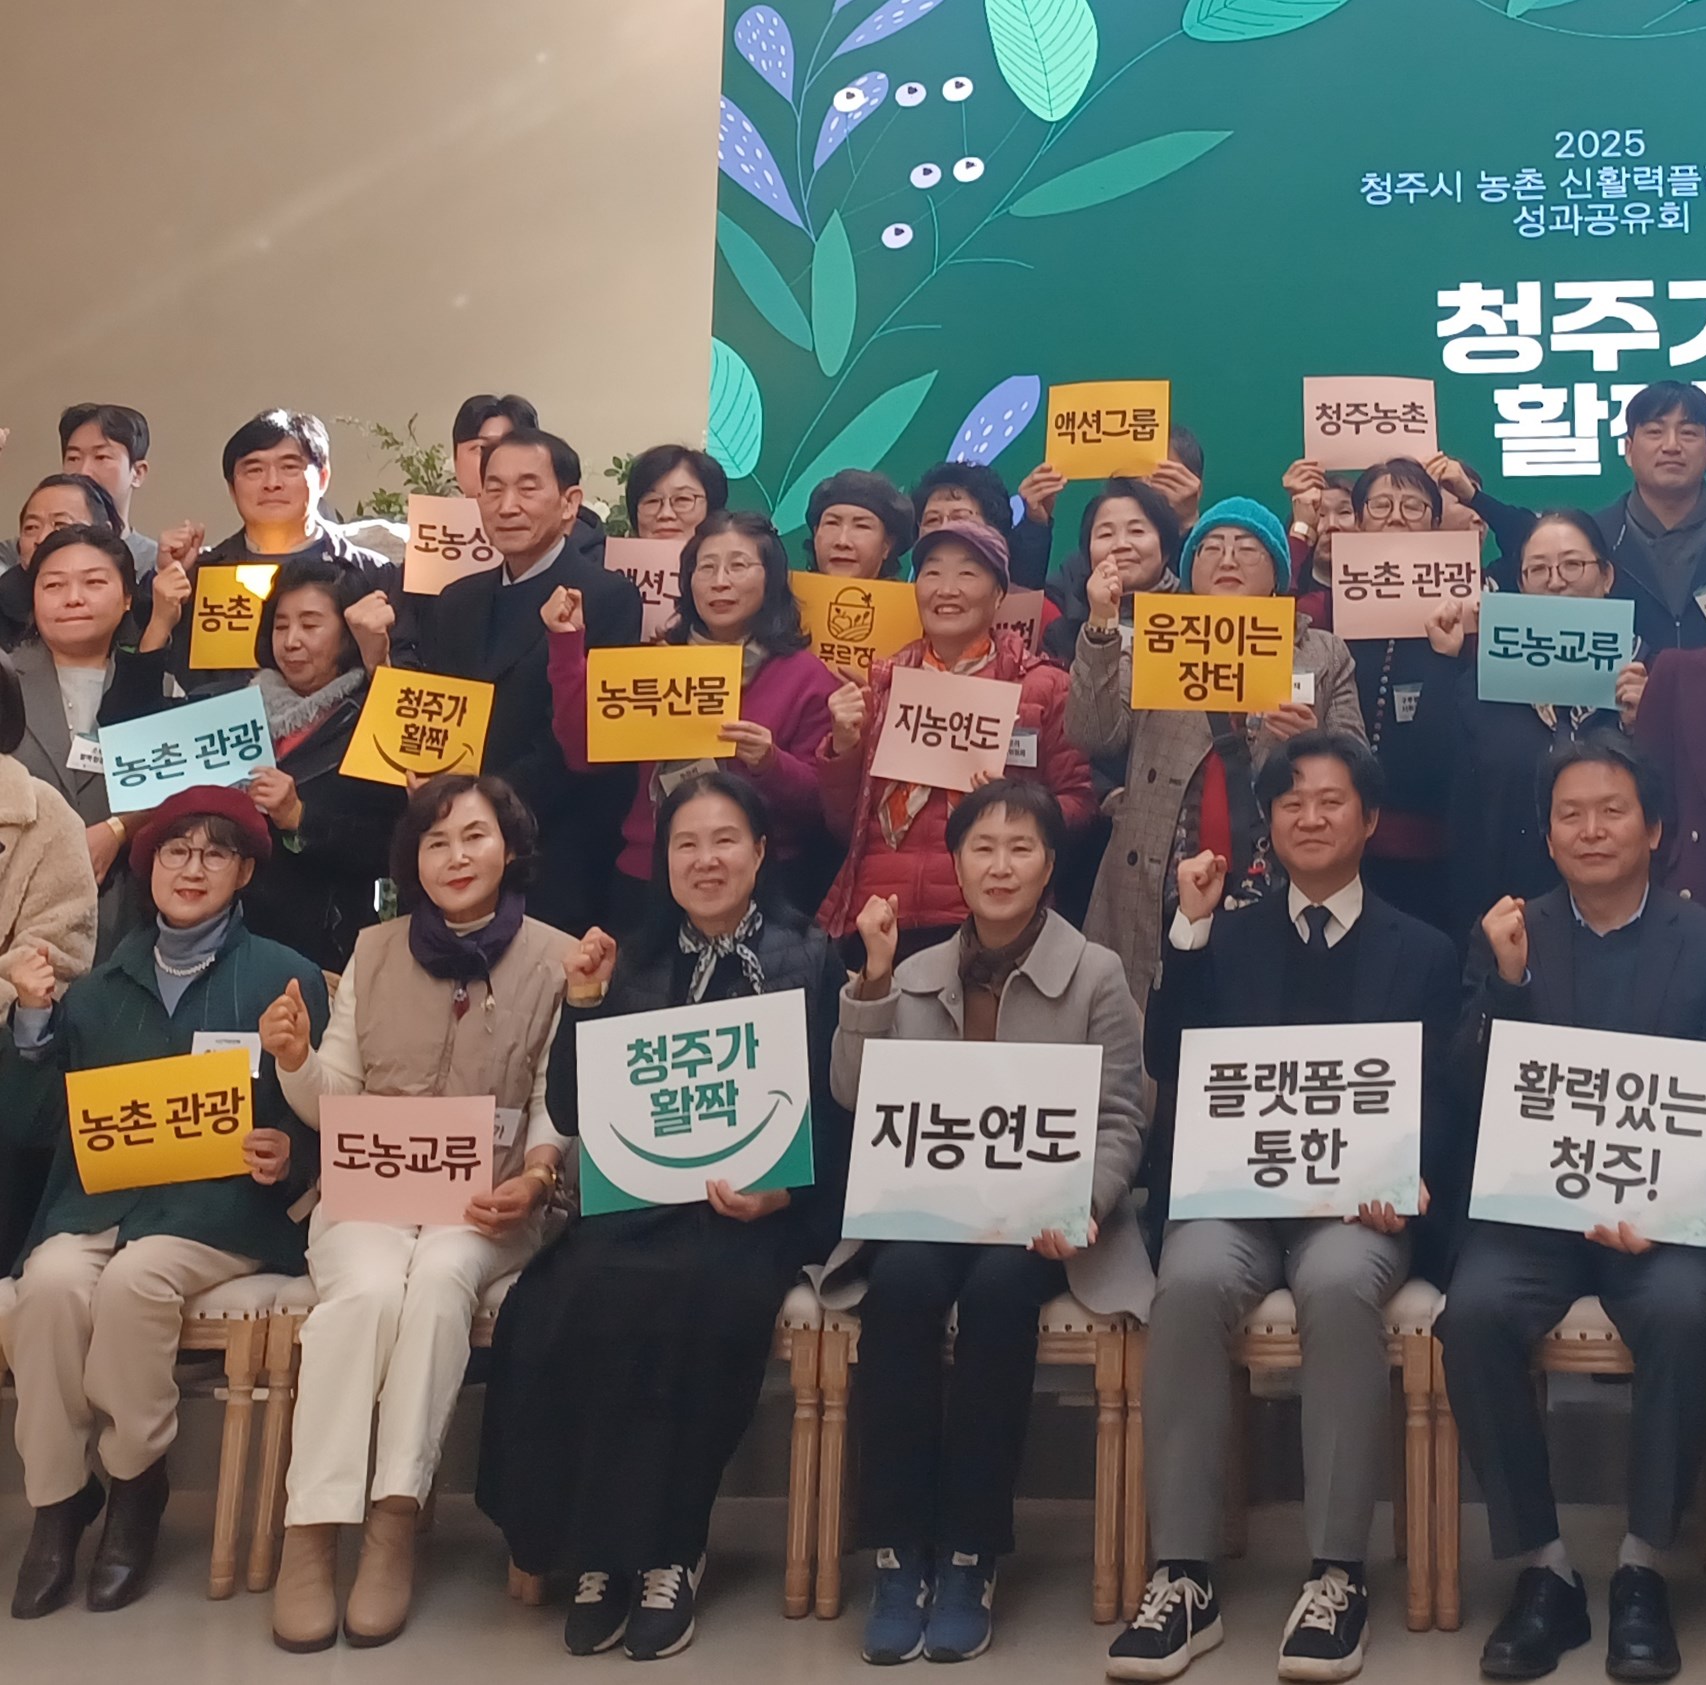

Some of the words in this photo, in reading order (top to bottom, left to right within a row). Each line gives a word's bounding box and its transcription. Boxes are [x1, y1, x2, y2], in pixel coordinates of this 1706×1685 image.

[1555, 129, 1645, 159] 2025
[1361, 170, 1463, 204] 청주시
[1477, 167, 1546, 201] 농촌
[1513, 201, 1690, 238] 성과공유회
[1054, 405, 1160, 445] 액션그룹
[1315, 401, 1429, 435] 청주농촌
[1338, 562, 1406, 598] 농촌
[1412, 559, 1477, 598] 관광
[198, 594, 254, 633] 농촌
[1144, 614, 1283, 657] 움직이는
[1487, 626, 1624, 672] 도농교류
[394, 686, 468, 721] 청주가
[596, 676, 730, 717] 농특산물
[1178, 662, 1246, 703] 장터
[401, 722, 449, 758] 활짝
[894, 704, 1001, 751] 지농연도
[112, 742, 188, 787] 농촌
[193, 721, 264, 770] 관광
[626, 1022, 759, 1086] 청주가
[650, 1078, 739, 1138] 활짝
[1203, 1058, 1397, 1117] 플랫폼을
[78, 1100, 156, 1152] 농촌
[165, 1086, 244, 1140] 관광
[871, 1101, 1082, 1170] 지농연도
[333, 1132, 482, 1182] 도농교류
[1248, 1128, 1348, 1188] 통한
[1550, 1136, 1661, 1204] 청주!
